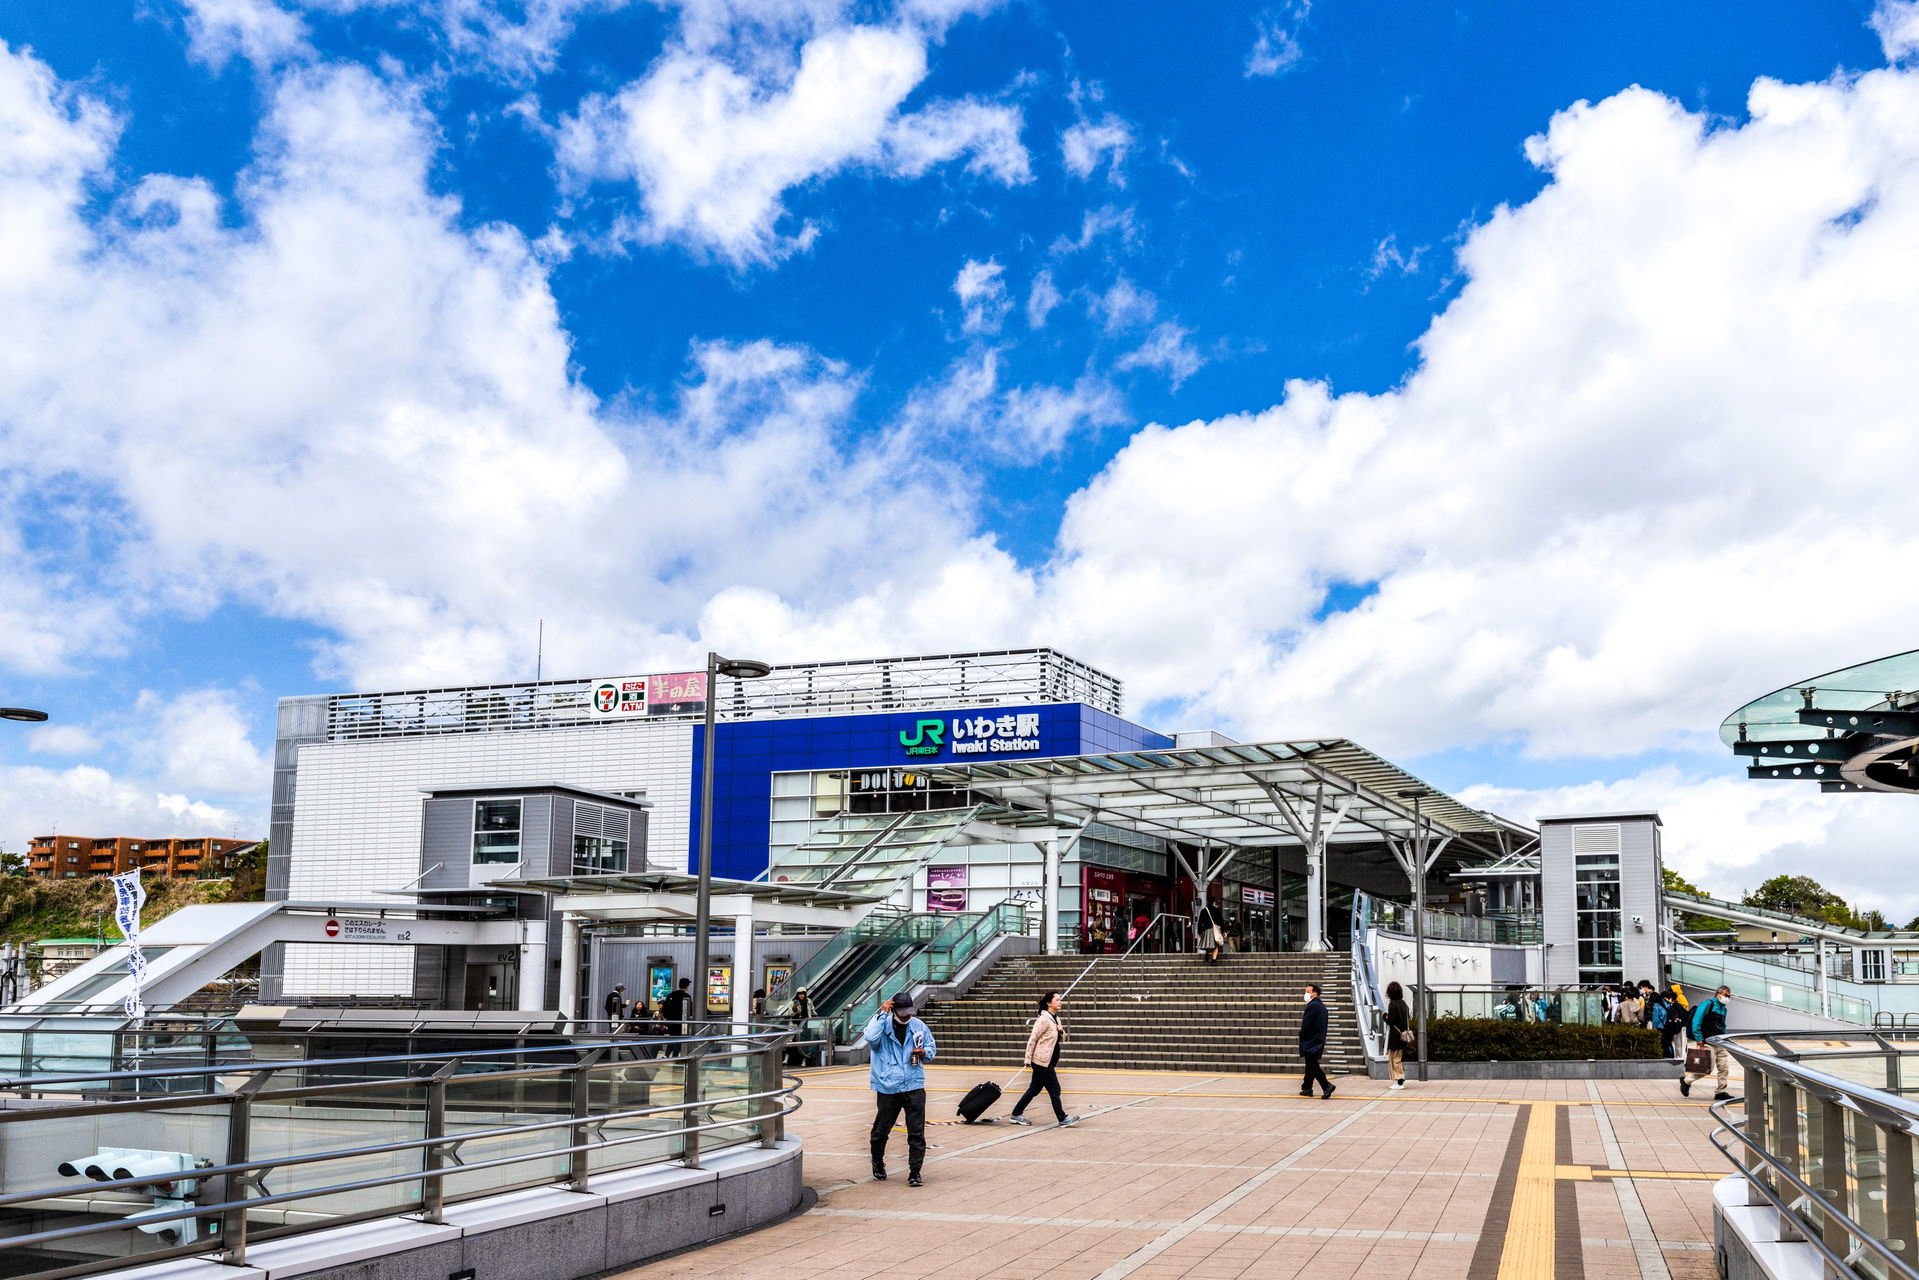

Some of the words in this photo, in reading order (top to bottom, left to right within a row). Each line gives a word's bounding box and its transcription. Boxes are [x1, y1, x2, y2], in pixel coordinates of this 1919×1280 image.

[651, 677, 702, 699] 半田屋
[623, 703, 643, 711] ATM
[900, 719, 945, 747] JR
[952, 713, 1040, 739] いわき駅
[952, 740, 988, 754] Iwaki
[989, 738, 1040, 752] Station
